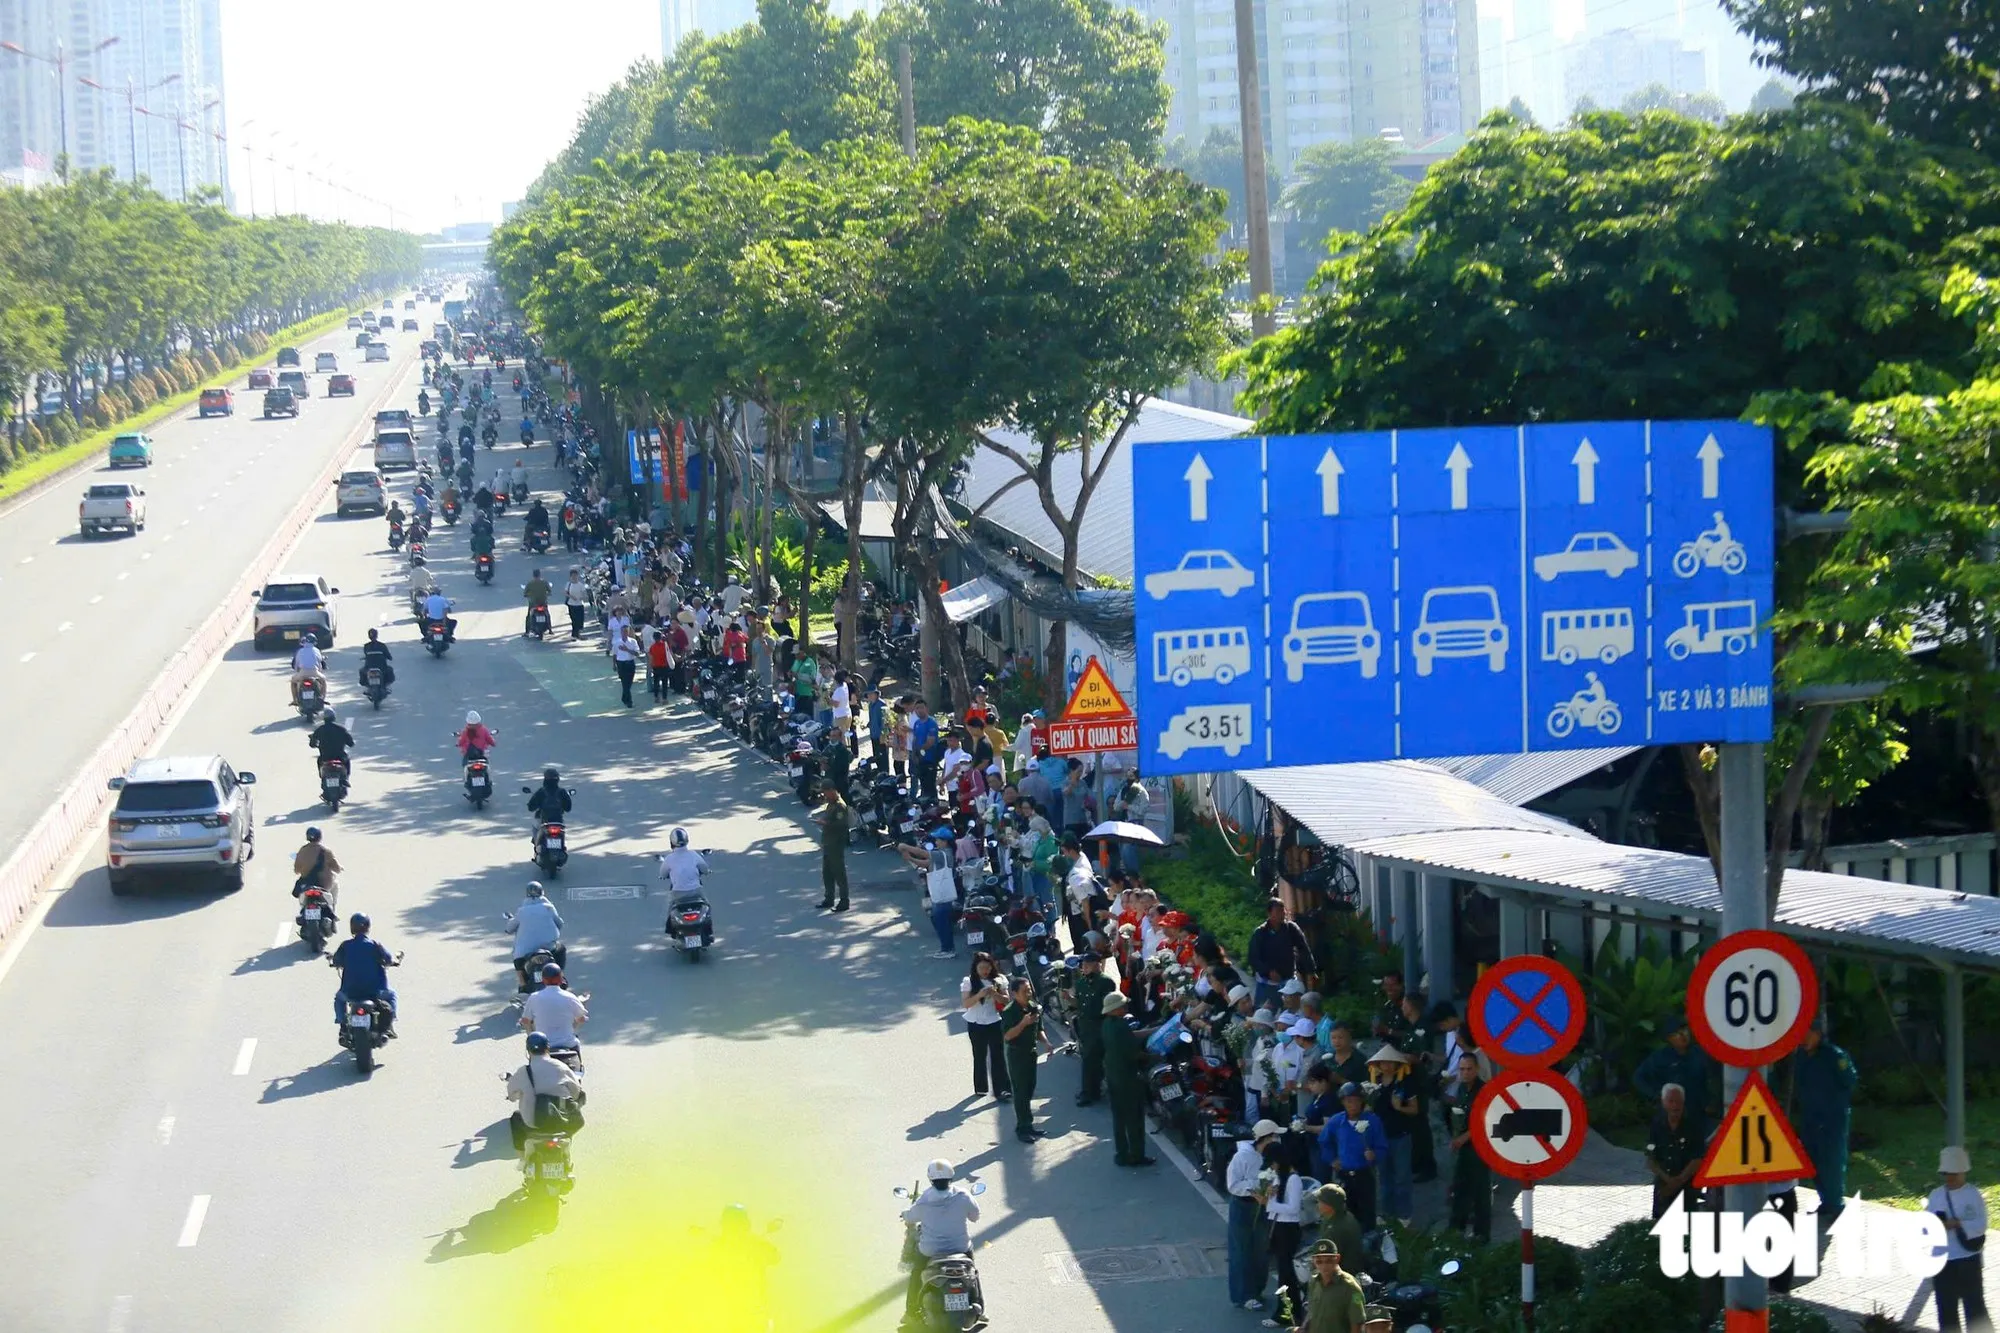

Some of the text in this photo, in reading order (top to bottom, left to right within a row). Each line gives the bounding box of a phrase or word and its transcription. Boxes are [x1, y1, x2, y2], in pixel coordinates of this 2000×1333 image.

[1089, 682, 1100, 692] ĐI
[1658, 681, 1769, 712] XE 2 VÀ 3 BÁNH
[1080, 696, 1112, 710] CHẬM
[1052, 721, 1138, 749] CHÚ Ý QUAN SÁ
[1184, 715, 1244, 739] <3,5t
[1725, 968, 1779, 1027] 60
